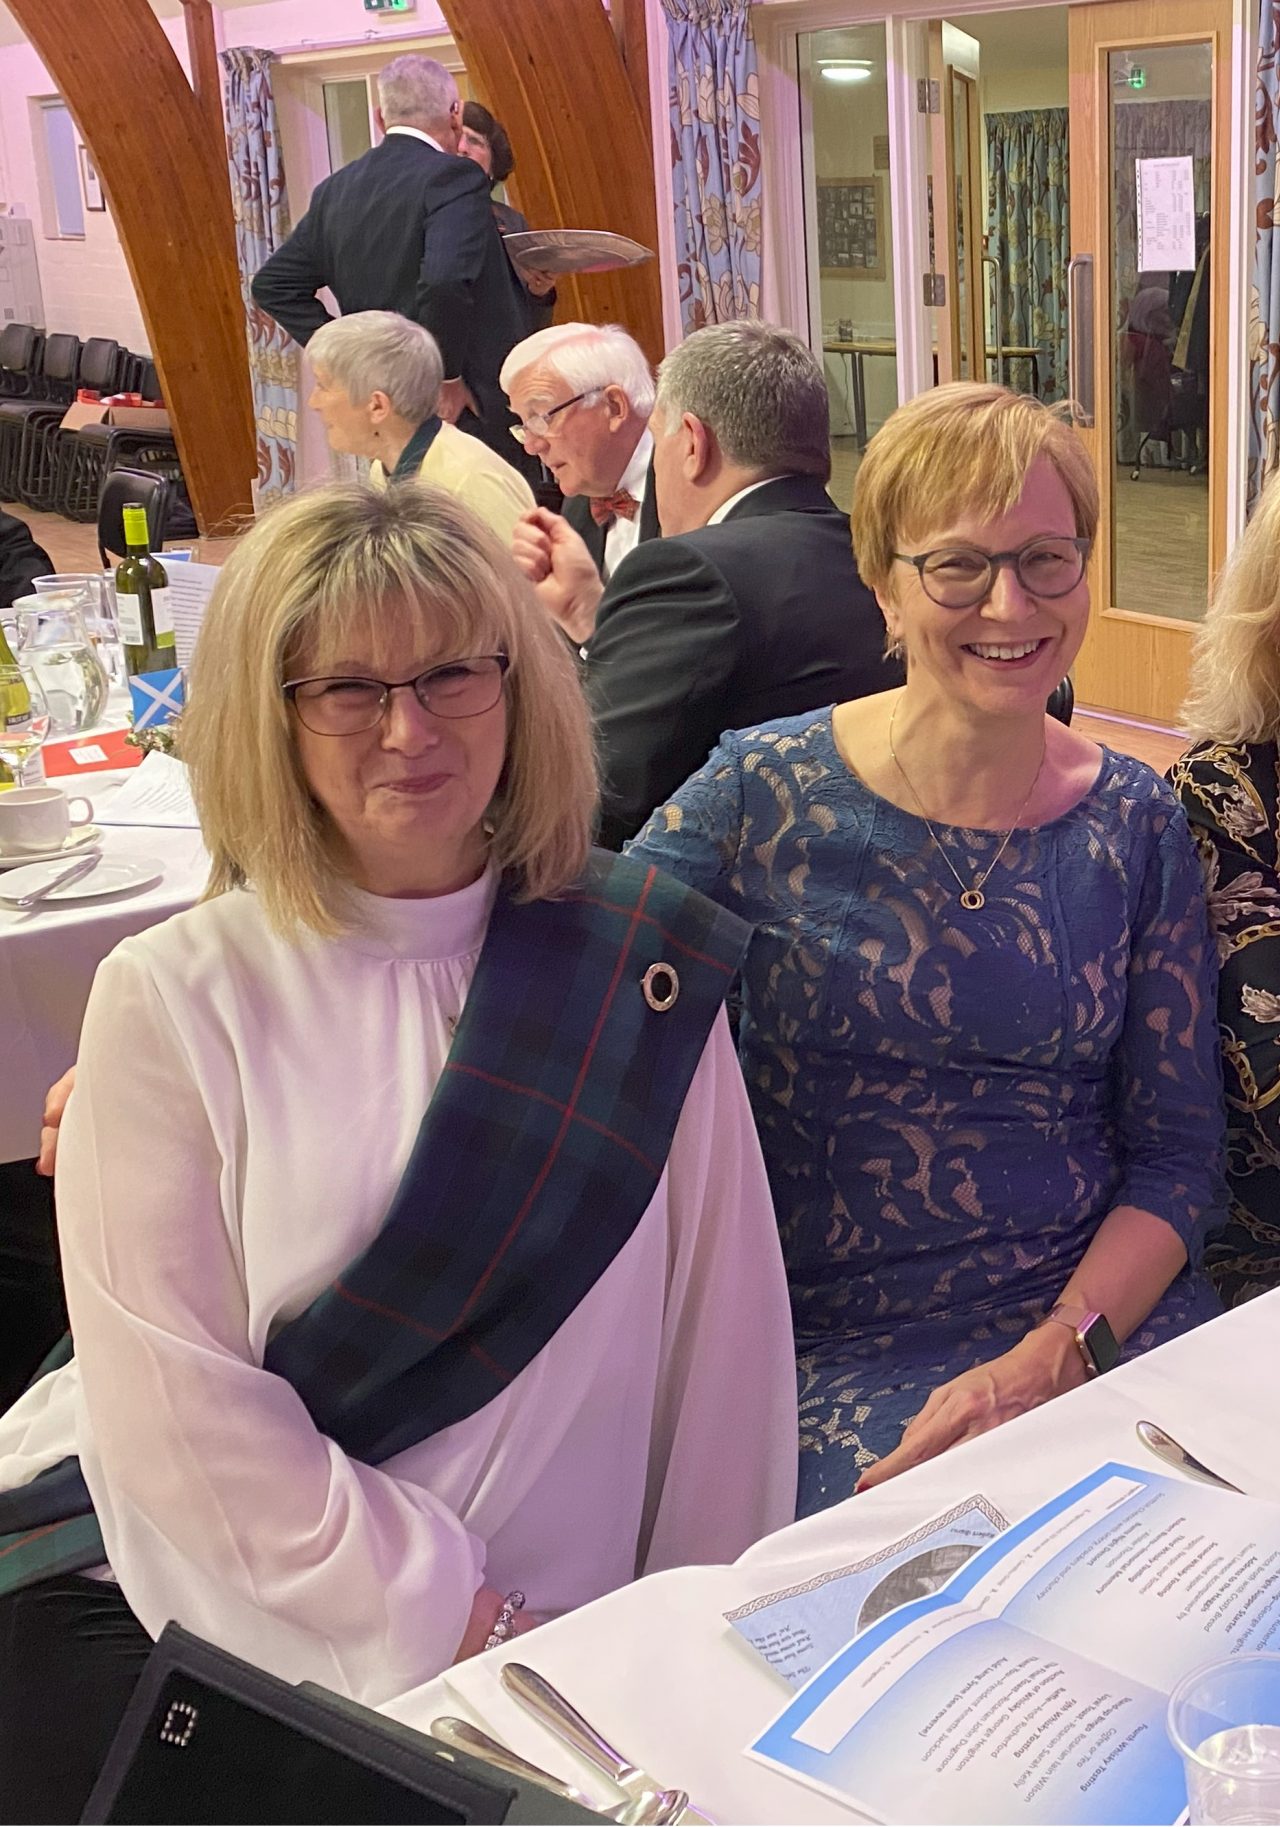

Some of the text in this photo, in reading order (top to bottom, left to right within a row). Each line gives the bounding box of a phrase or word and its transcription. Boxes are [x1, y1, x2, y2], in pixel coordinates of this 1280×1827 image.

[1148, 1546, 1170, 1564] Whisky
[1127, 1563, 1150, 1582] Tasting
[1156, 1541, 1217, 1597] Second Whisky Tasting
[1156, 1566, 1169, 1577] and
[1234, 1556, 1257, 1576] Address
[1247, 1567, 1264, 1581] Broth
[1218, 1582, 1230, 1592] the
[1235, 1581, 1250, 1593] with
[1261, 1574, 1278, 1589] Night
[1199, 1592, 1221, 1612] Haggis
[1218, 1593, 1238, 1611] Crusty
[1242, 1589, 1264, 1609] Supper
[1175, 1611, 1186, 1620] by
[1203, 1611, 1221, 1631] Bread
[1224, 1610, 1246, 1632] Starter
[1038, 1670, 1064, 1686] Auction
[917, 1658, 1008, 1735] Auld Lang Syne (see reverse)
[1007, 1691, 1034, 1712] Whisky
[920, 1656, 1038, 1761] Thank Annette Jackson
[934, 1661, 1058, 1772] The Final John Dugmore
[983, 1714, 1009, 1737] George
[1012, 1698, 1076, 1757] Fifth Whisky Tasting
[1083, 1716, 1105, 1732] Bingo
[989, 1721, 1027, 1757] Rutherford
[1012, 1693, 1111, 1787] Loyal Toast Rotarian Sarah Kelly
[1057, 1733, 1086, 1761] Rotarian
[1094, 1728, 1116, 1746] Coffee
[953, 1737, 986, 1771] Heighton
[1076, 1754, 1090, 1767] Tea
[1079, 1723, 1147, 1791] Fourth Whisky Tasting
[1023, 1775, 1047, 1802] Wilson
